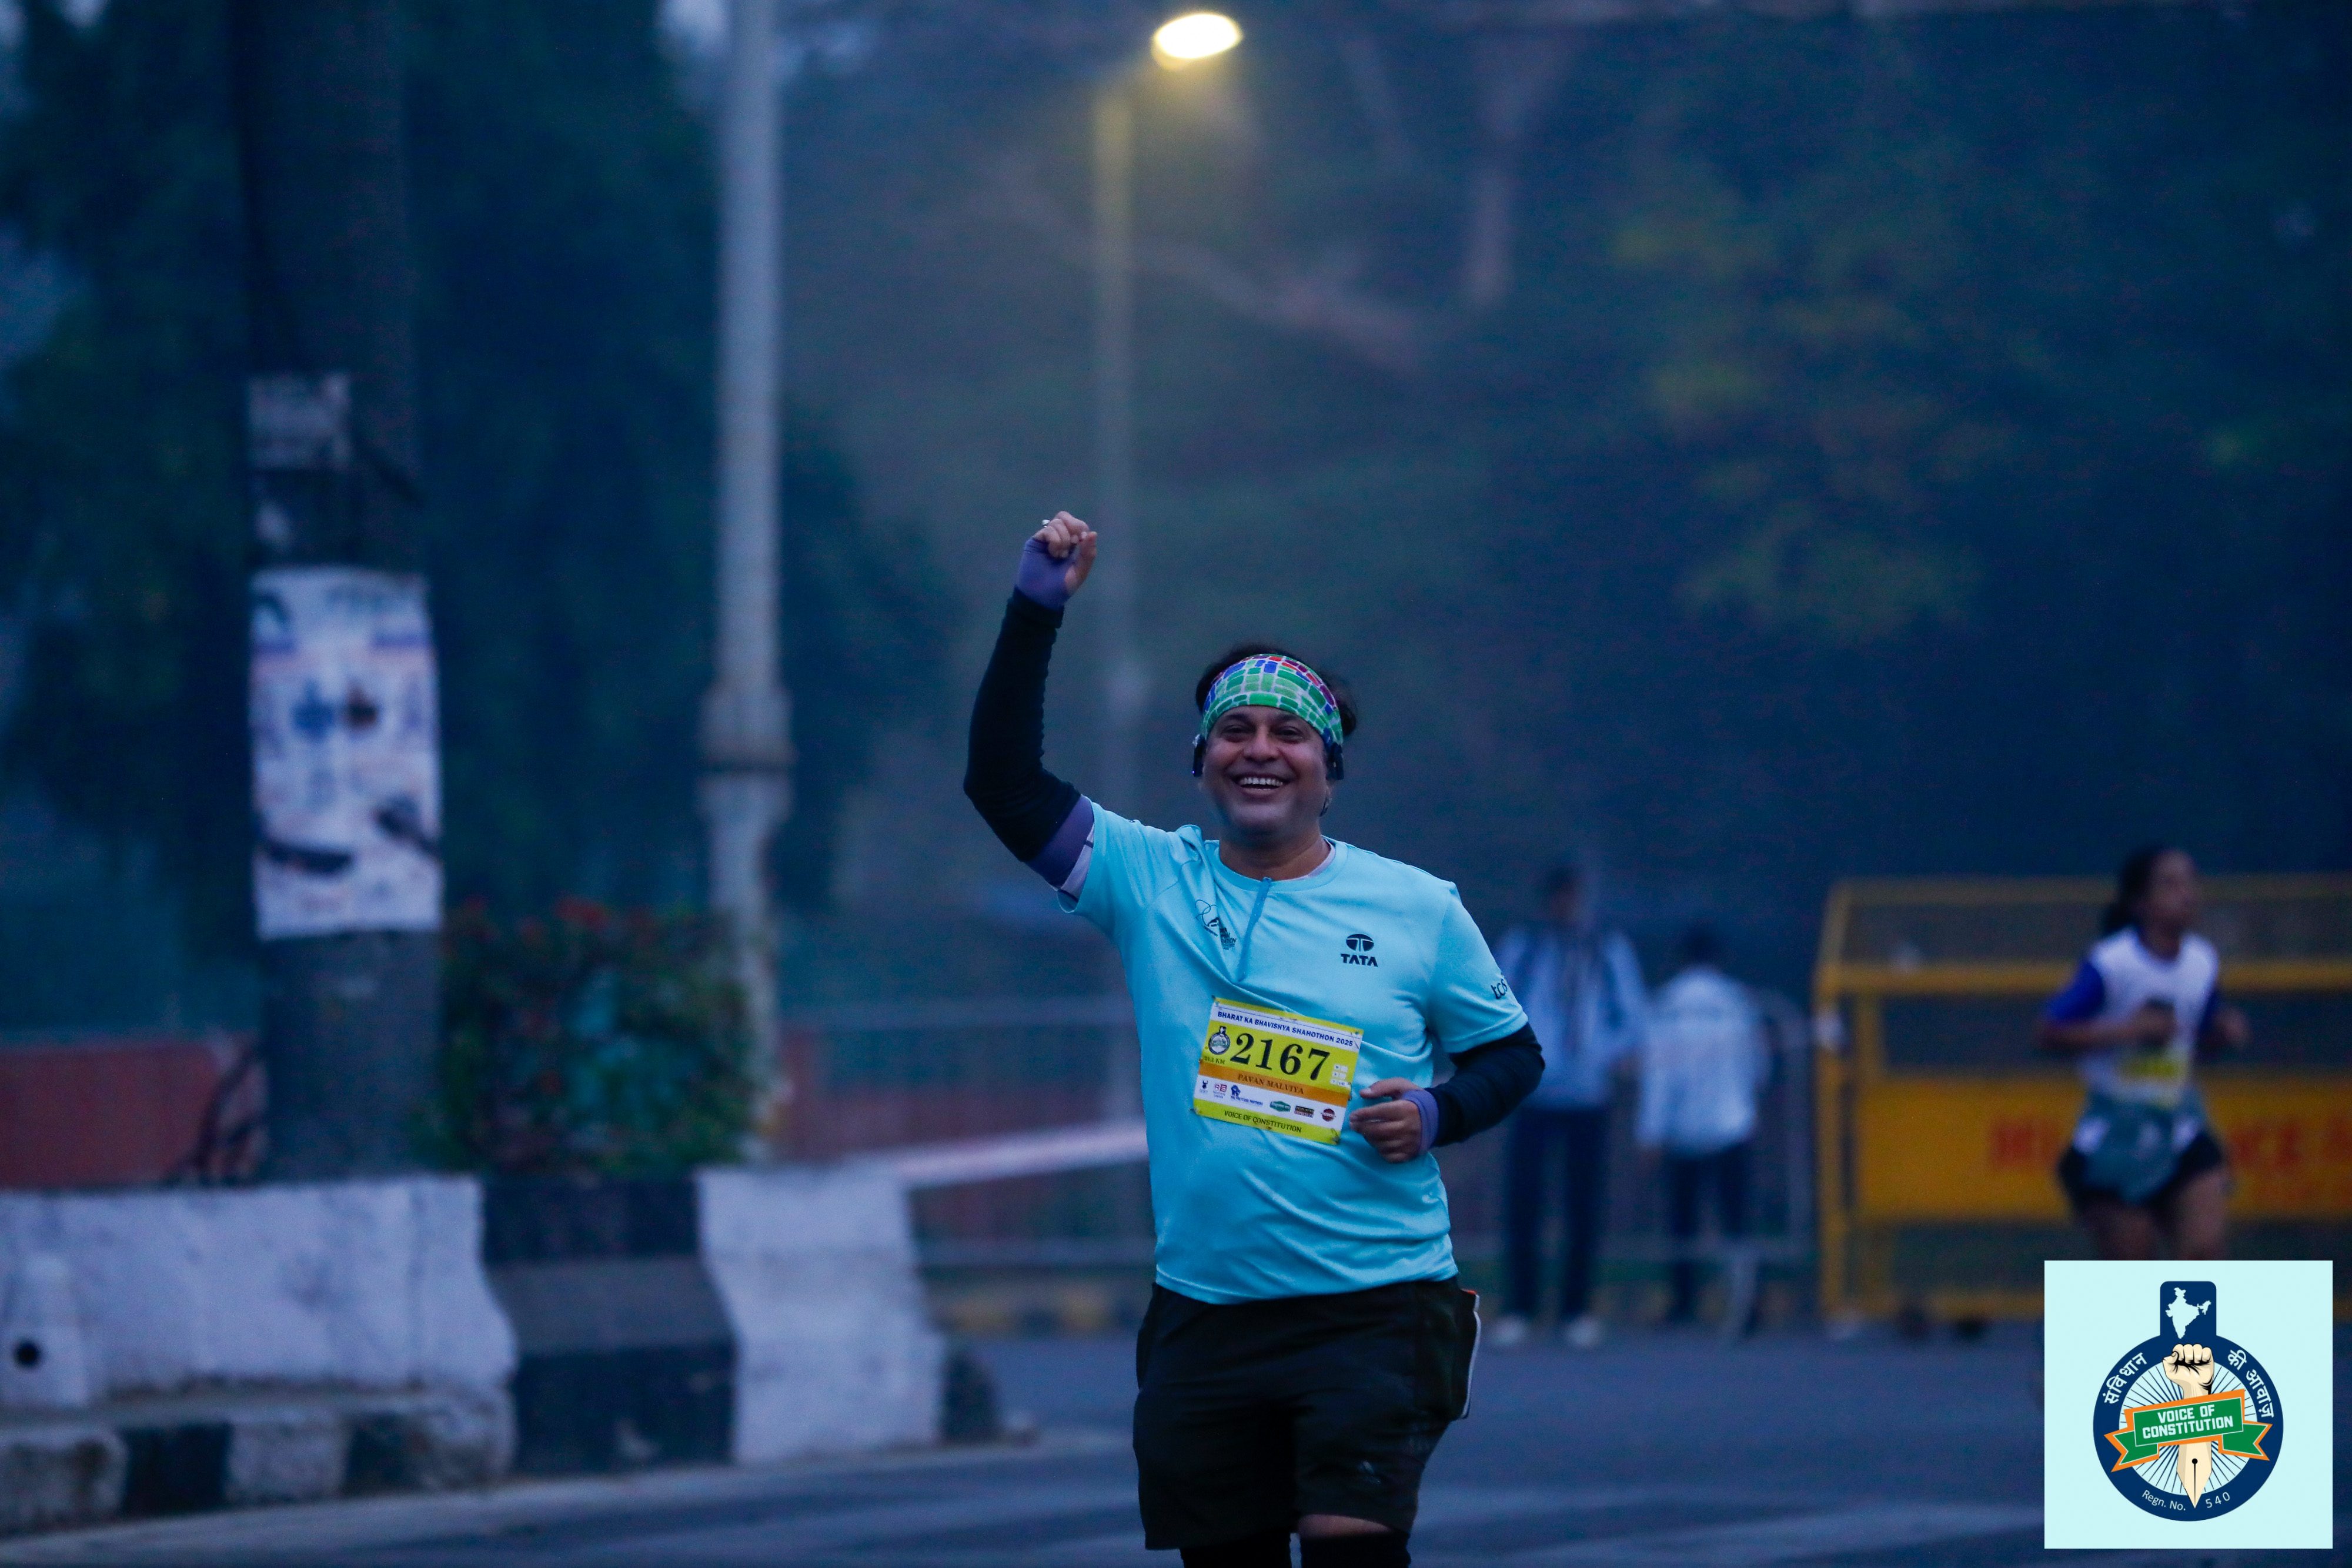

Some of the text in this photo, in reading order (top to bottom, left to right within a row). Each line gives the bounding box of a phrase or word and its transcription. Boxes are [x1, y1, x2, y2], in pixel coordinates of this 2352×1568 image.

[1340, 954, 1378, 968] TATA
[1491, 978, 1508, 999] tcs
[1217, 1011, 1354, 1047] BHARAT KA BHAVISHYA SHAHOTHON 2025
[1230, 1032, 1331, 1081] 2167
[1238, 1074, 1304, 1095] PAVAN MALVIYA
[1224, 1110, 1242, 1121] VOICE
[1252, 1116, 1302, 1133] CONSTITUTION
